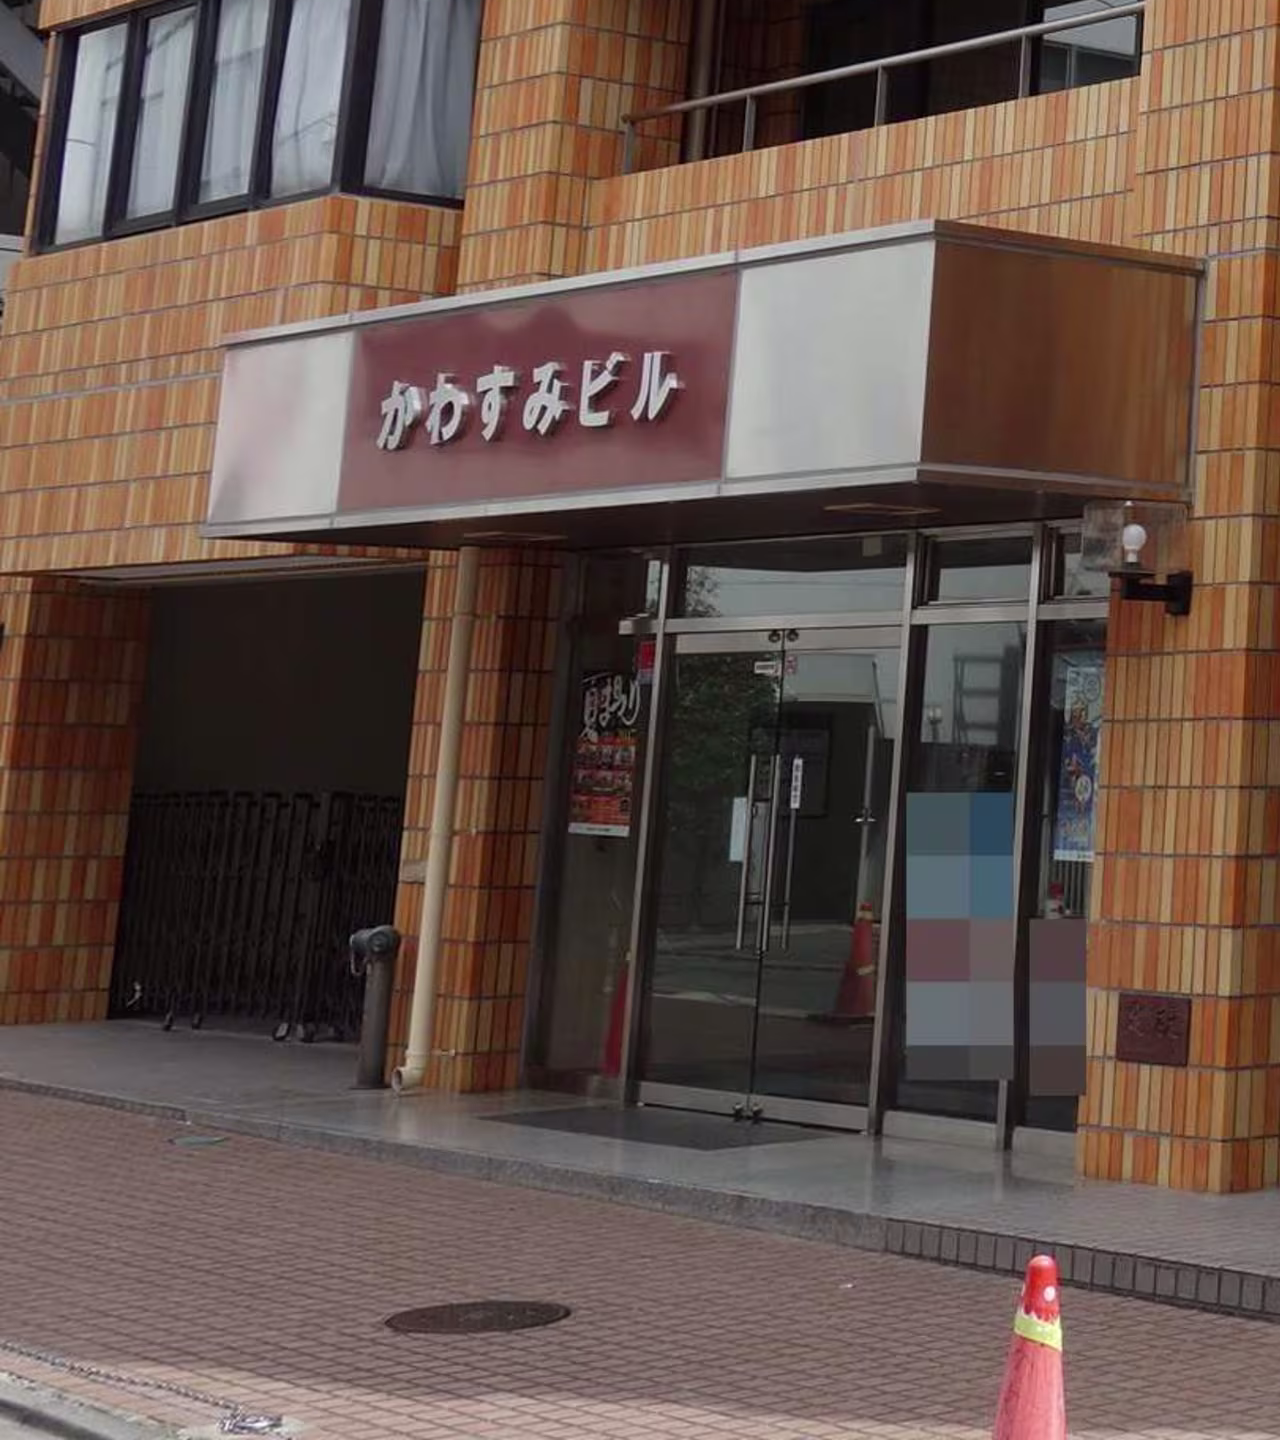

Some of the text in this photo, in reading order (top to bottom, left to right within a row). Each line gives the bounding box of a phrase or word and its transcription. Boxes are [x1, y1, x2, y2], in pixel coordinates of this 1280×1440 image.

[376, 351, 682, 450] かわすみビル
